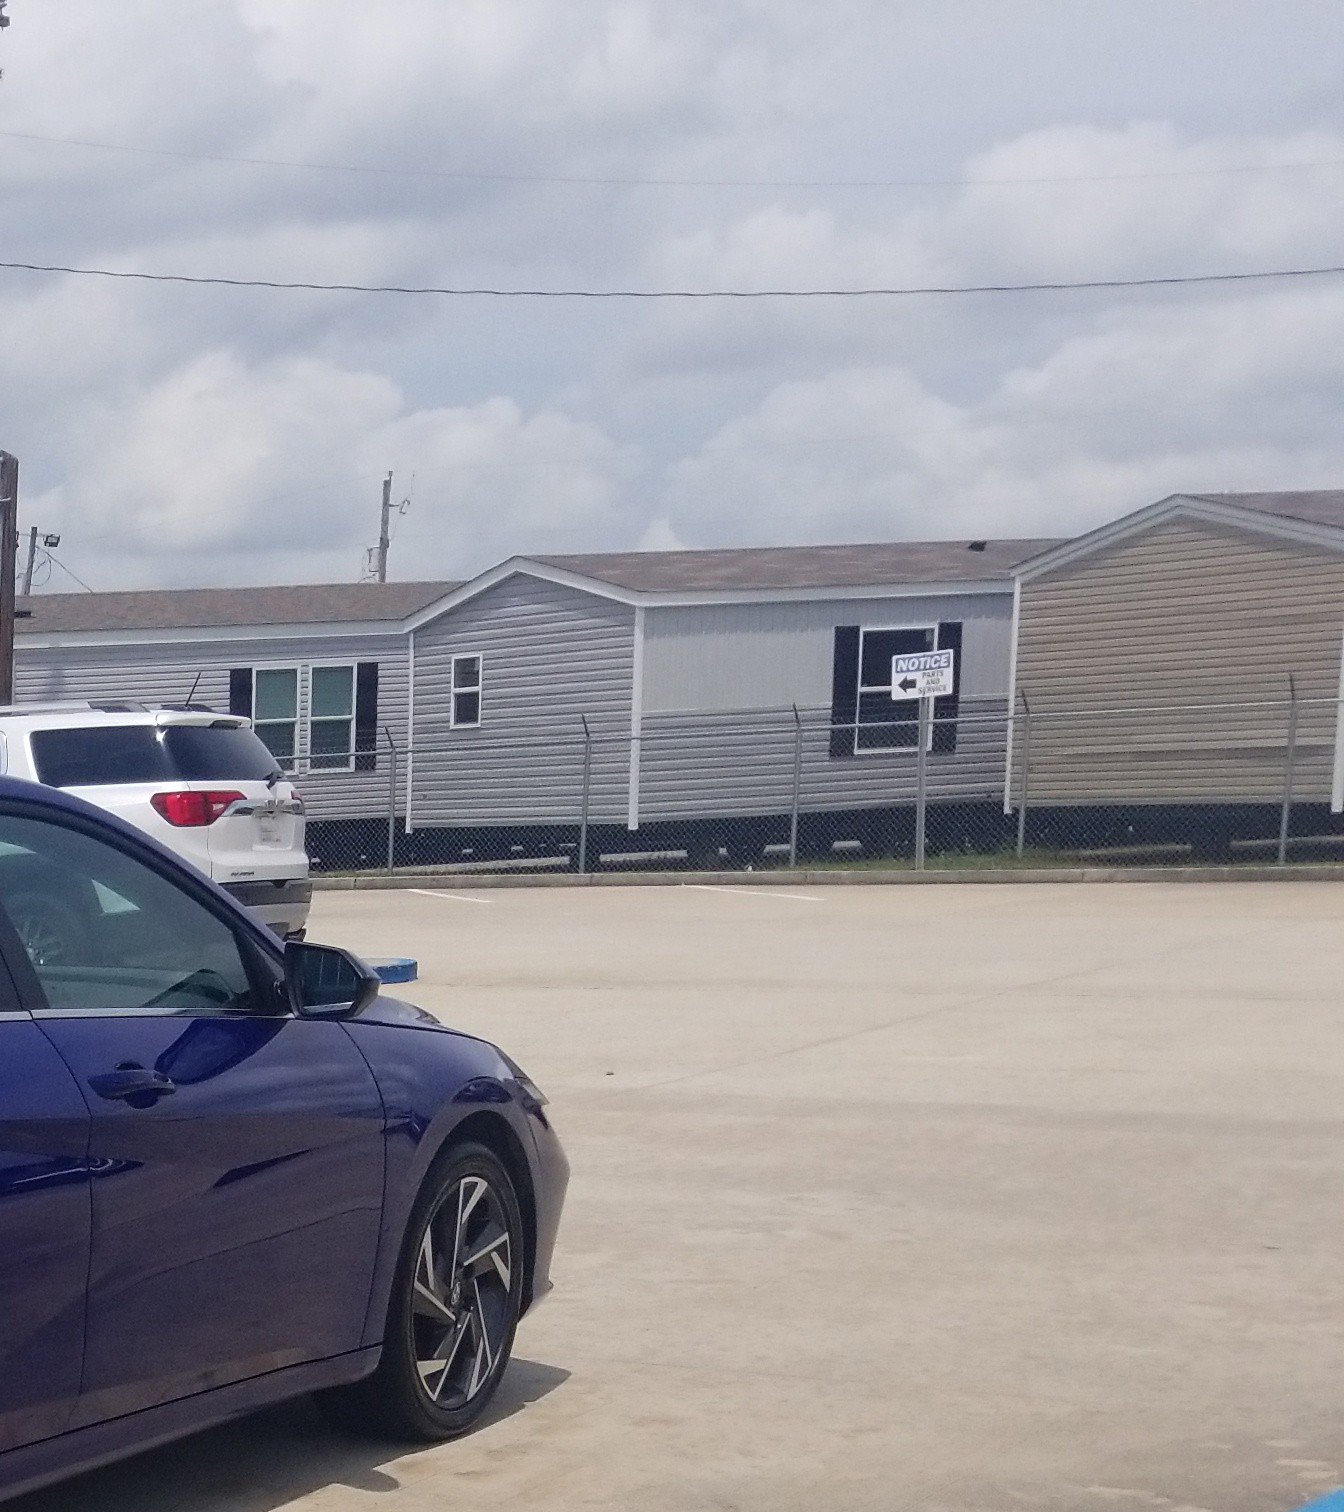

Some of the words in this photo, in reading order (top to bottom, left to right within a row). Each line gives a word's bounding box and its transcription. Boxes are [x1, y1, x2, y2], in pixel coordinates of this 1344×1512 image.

[896, 654, 950, 672] NOTICE
[922, 670, 944, 678] PARTS
[926, 678, 940, 686] AND
[918, 684, 947, 696] SERVICE
